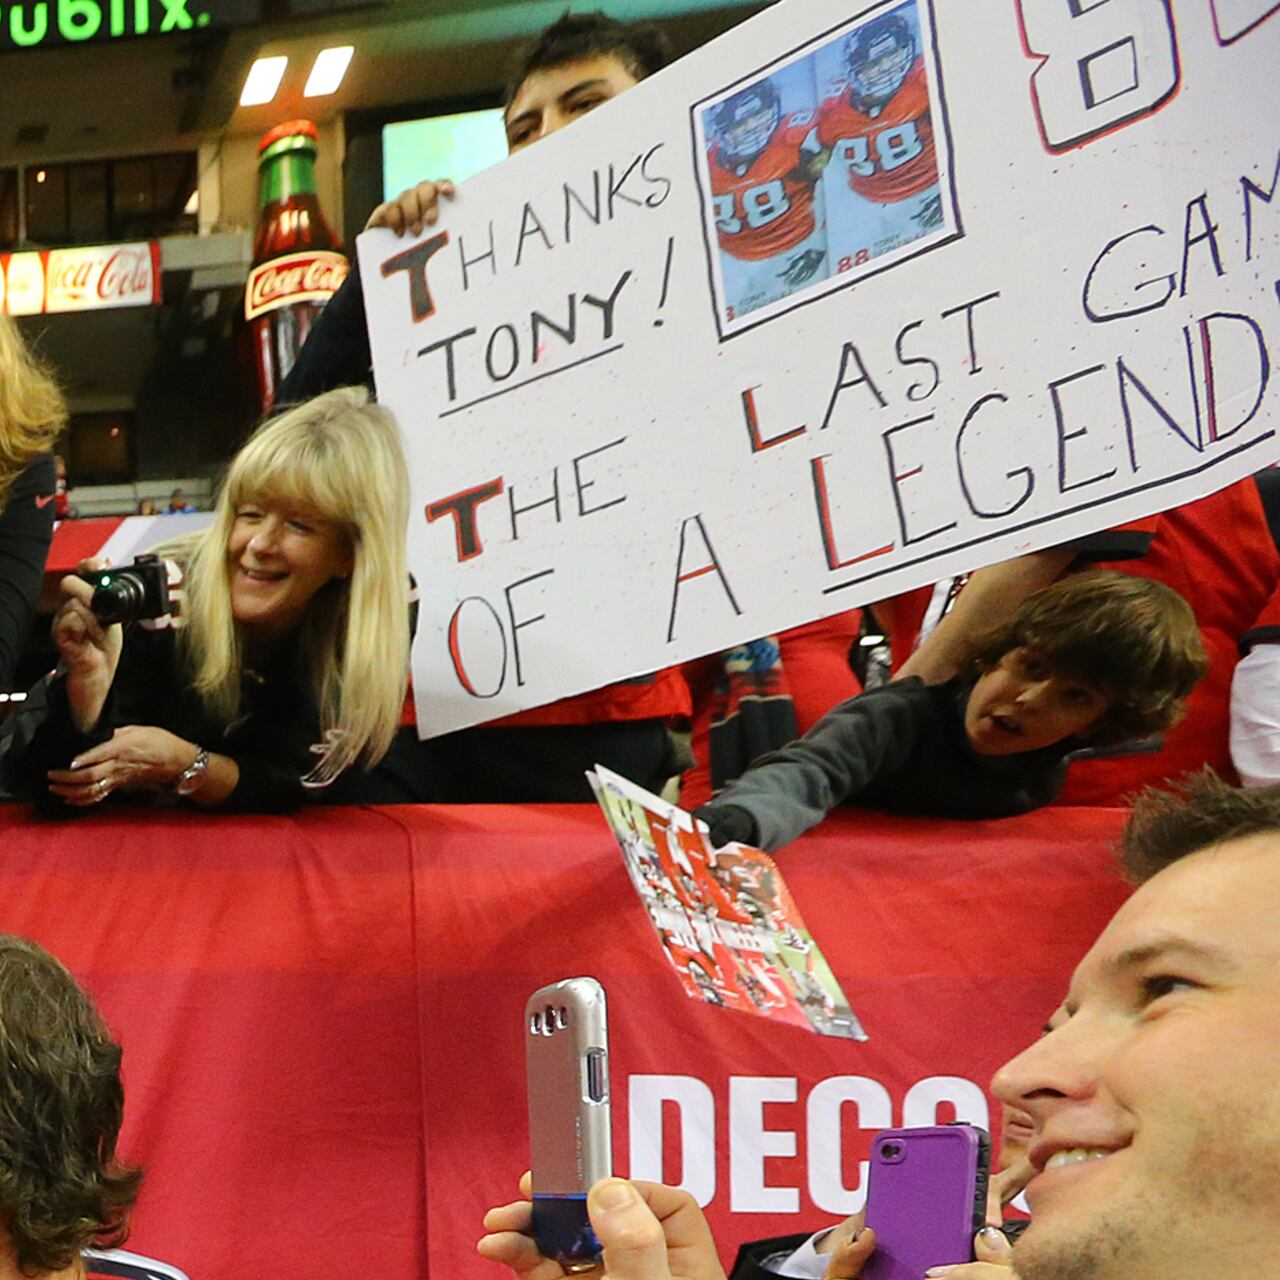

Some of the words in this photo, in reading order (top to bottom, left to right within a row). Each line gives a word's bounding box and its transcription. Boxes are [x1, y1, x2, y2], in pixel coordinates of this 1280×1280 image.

[380, 143, 671, 324] THANKS
[417, 236, 674, 401] TONY!
[837, 248, 870, 274] 88
[424, 435, 627, 563] THE
[741, 291, 1000, 453] LAST
[448, 568, 555, 699] OF
[666, 512, 743, 644] A
[811, 311, 1271, 571] LEGEND
